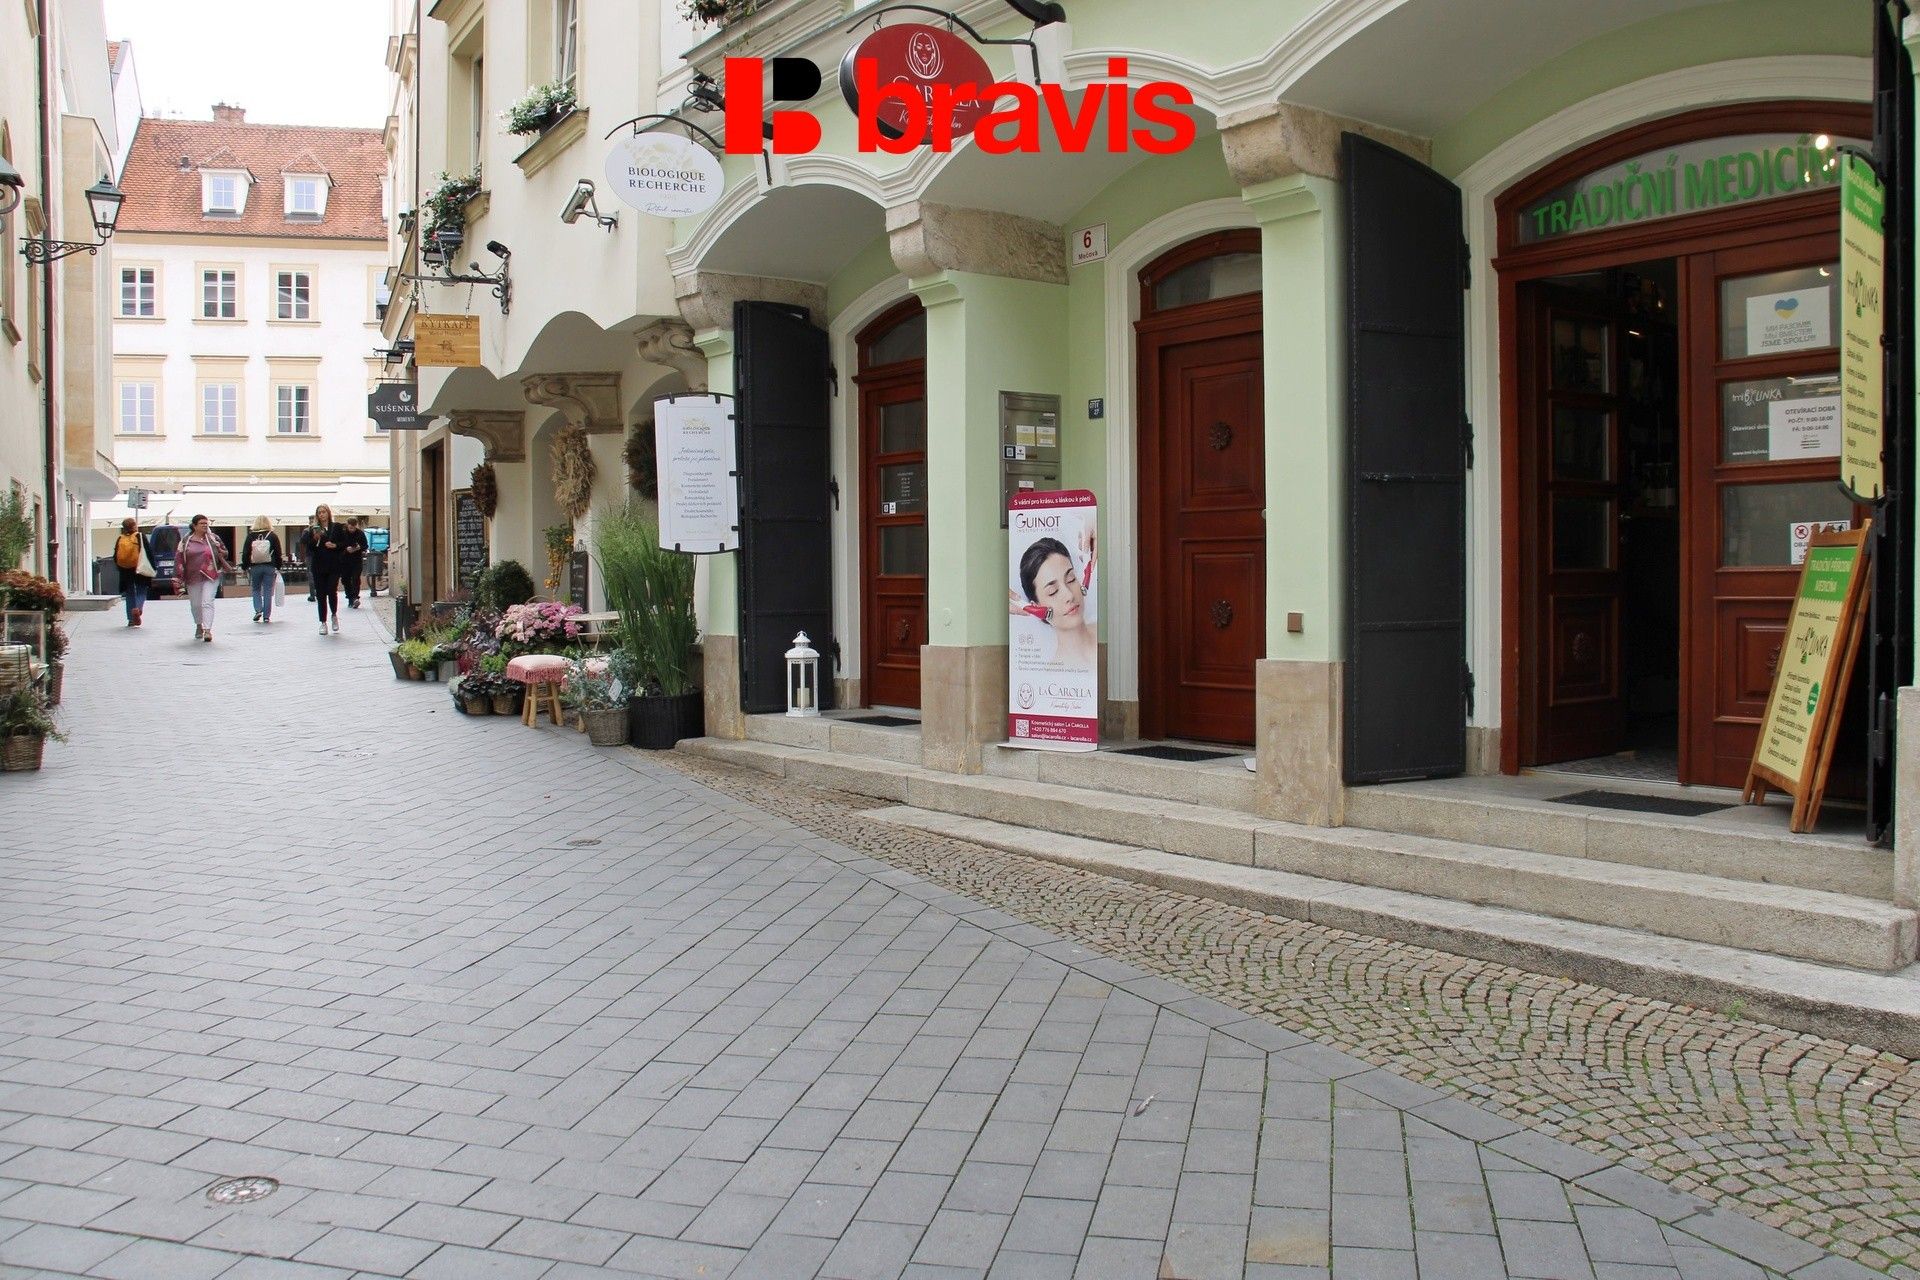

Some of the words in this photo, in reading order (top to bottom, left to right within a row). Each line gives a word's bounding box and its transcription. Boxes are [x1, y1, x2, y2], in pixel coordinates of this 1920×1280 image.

[628, 166, 706, 183] BIOLOGIQUE
[629, 179, 707, 193] RECHERCHE
[1533, 152, 1676, 236] TRADIČNÍ
[1684, 135, 1841, 209] MEDICÍN
[1083, 230, 1092, 248] 6
[1760, 339, 1782, 348] JSME
[375, 402, 418, 413] SUŠENKÁ
[1785, 406, 1817, 415] OTEVÍRACÍ
[1818, 405, 1836, 413] DOBA
[1015, 513, 1061, 528] GUINOT
